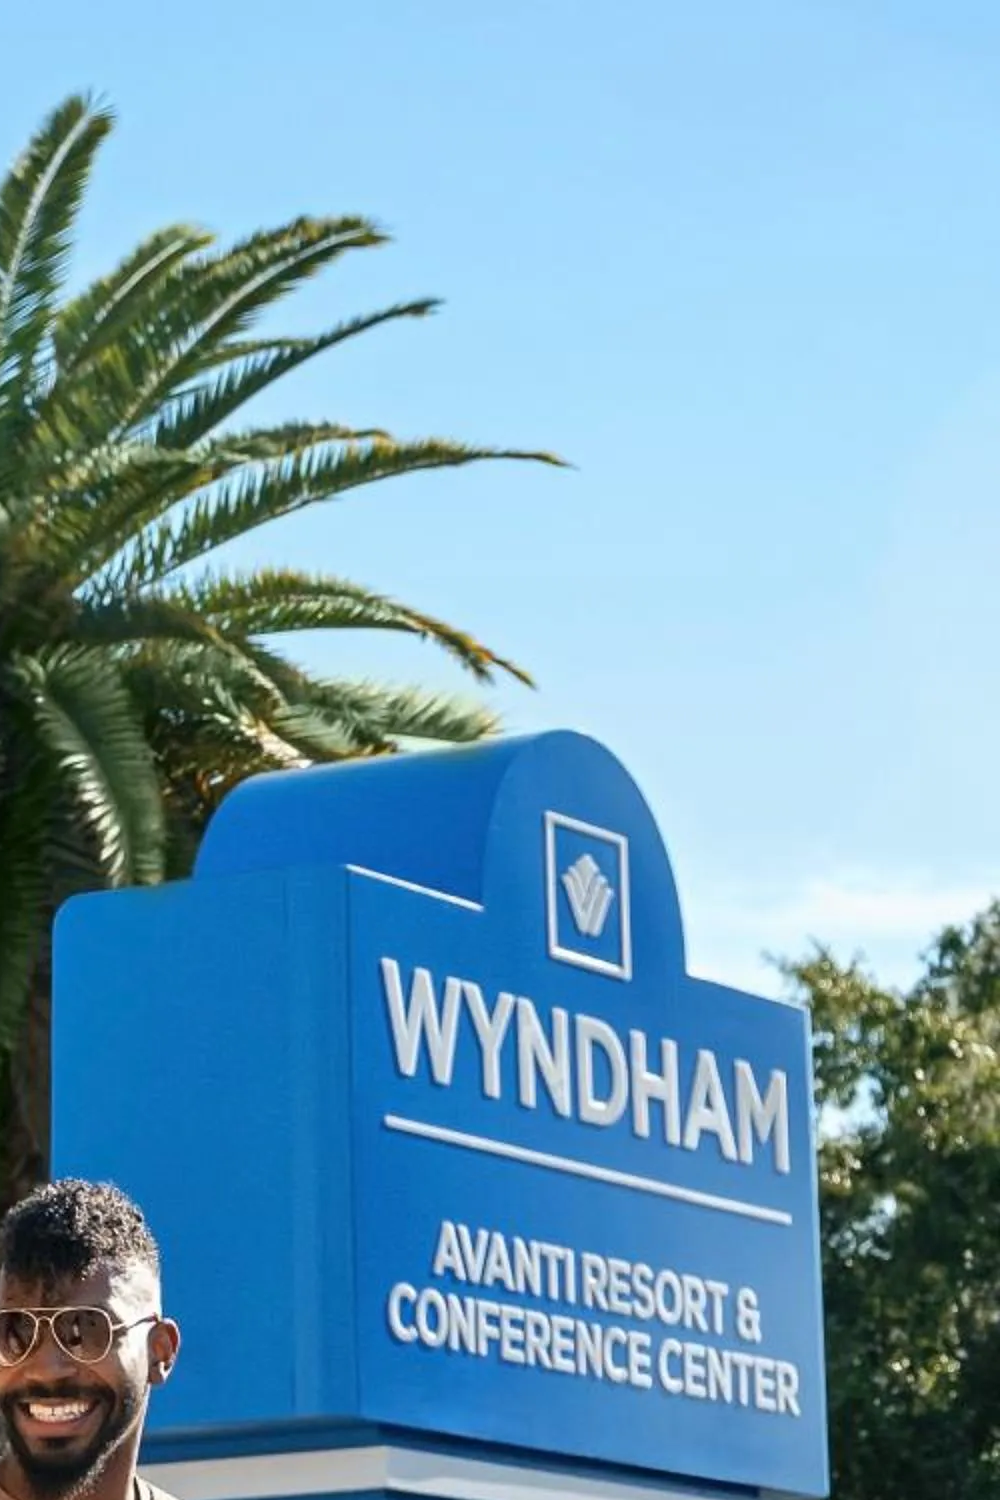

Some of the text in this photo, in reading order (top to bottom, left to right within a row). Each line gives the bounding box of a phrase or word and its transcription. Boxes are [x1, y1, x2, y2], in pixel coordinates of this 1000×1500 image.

[381, 958, 790, 1174] WYNDHAM
[388, 1282, 801, 1417] CONFERENCE CENTER
[434, 1220, 762, 1344] AVANTI RESORT &
